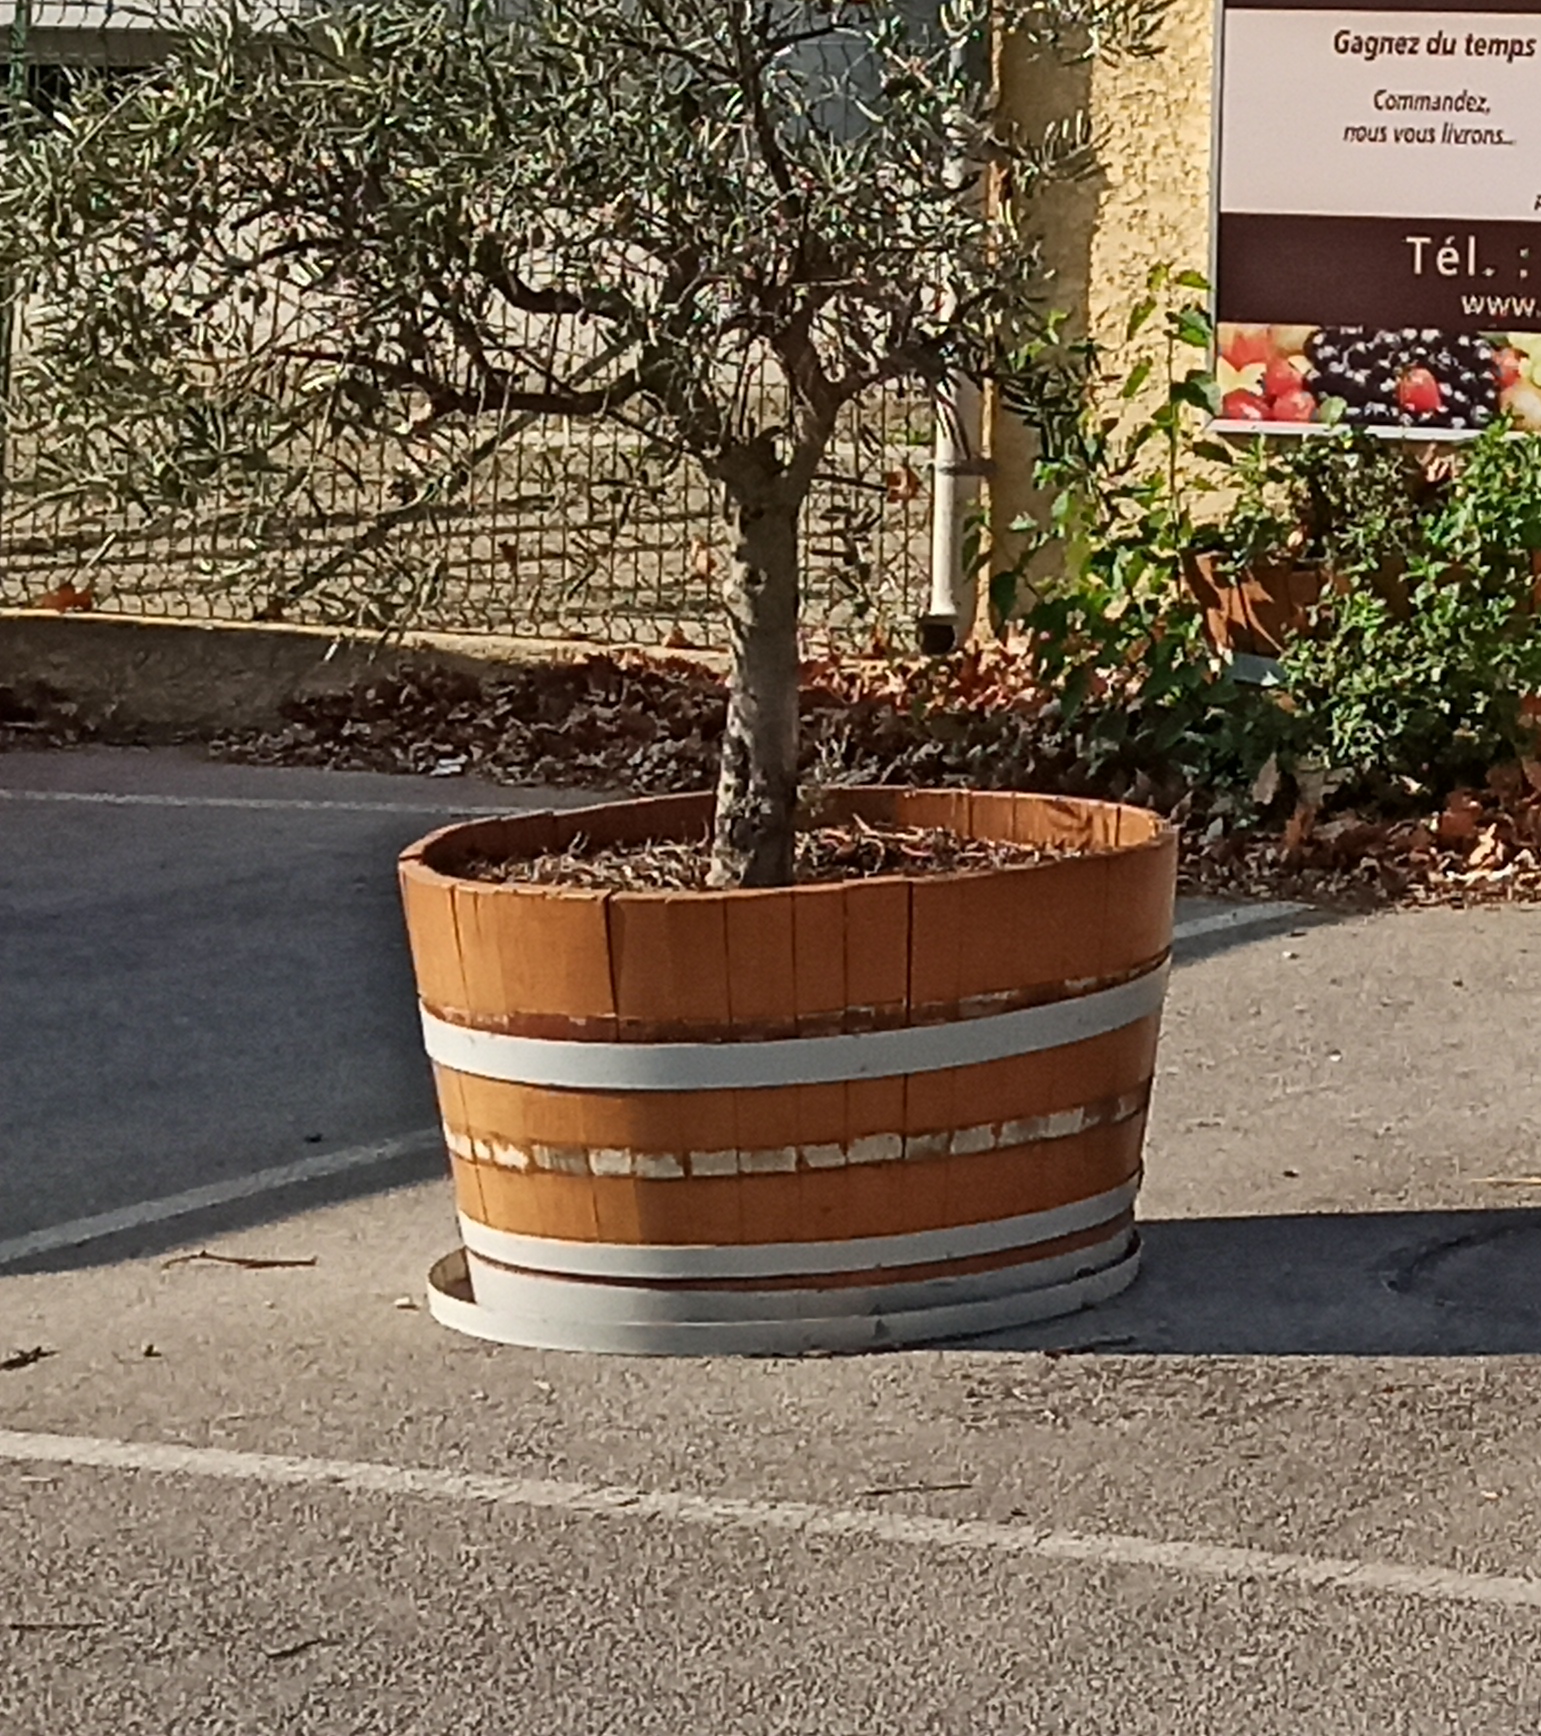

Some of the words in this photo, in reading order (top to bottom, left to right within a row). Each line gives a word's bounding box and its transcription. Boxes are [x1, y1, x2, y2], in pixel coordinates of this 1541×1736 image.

[1333, 29, 1420, 61] Gagnez
[1426, 30, 1457, 57] du
[1464, 33, 1538, 63] temps
[1373, 89, 1492, 115] Commandez,
[1343, 125, 1388, 144] nous
[1393, 126, 1436, 145] vous
[1405, 235, 1495, 277] Tél.
